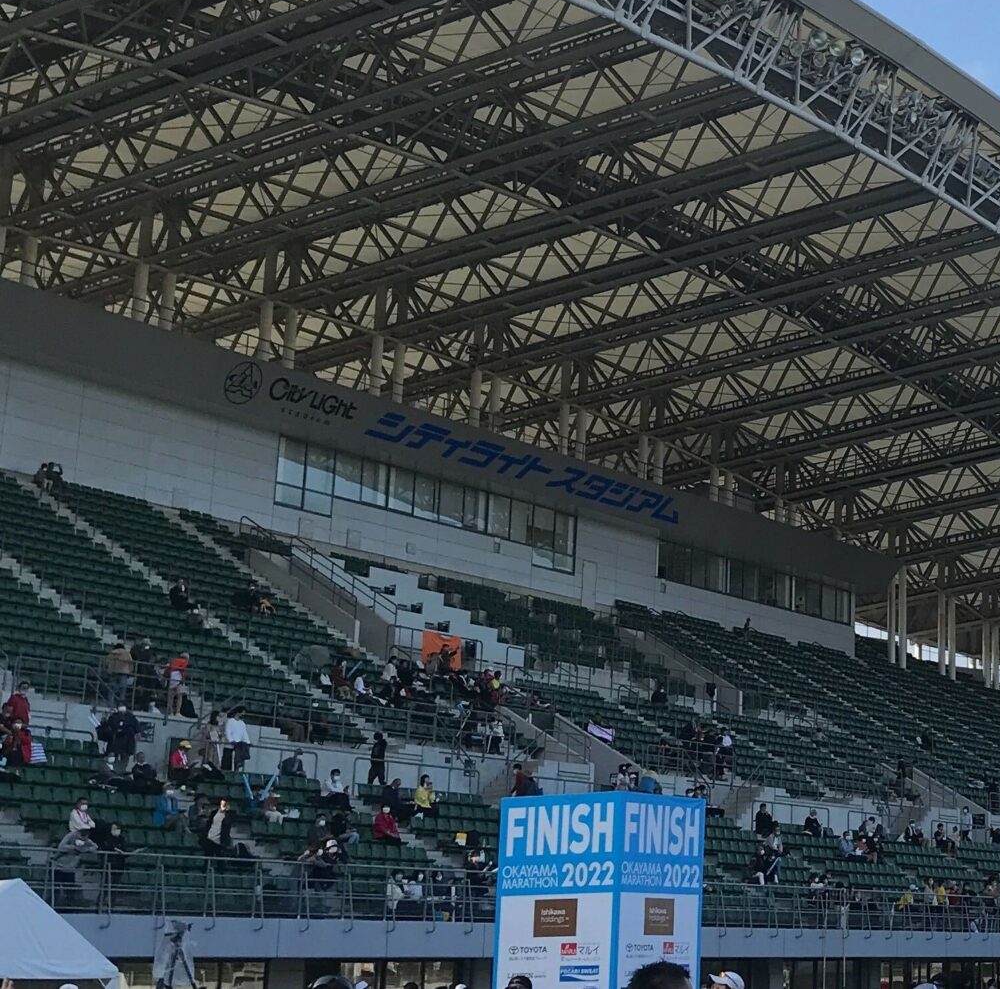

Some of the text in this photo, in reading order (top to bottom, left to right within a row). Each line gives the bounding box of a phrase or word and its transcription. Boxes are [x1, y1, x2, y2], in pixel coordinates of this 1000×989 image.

[364, 412, 680, 524] シティライト スタジアム
[505, 802, 614, 858] FINISH
[624, 801, 700, 857] FINISH
[502, 864, 558, 879] OKAYAMA
[561, 861, 614, 888] 2022
[621, 861, 662, 875] OKAYAMA
[502, 876, 558, 890] MARATHON
[621, 873, 662, 887] MARATHON
[664, 864, 699, 889] 2022
[520, 945, 548, 953] TOYOTA
[578, 944, 600, 955] マルイ
[633, 943, 654, 952] TOYOTA
